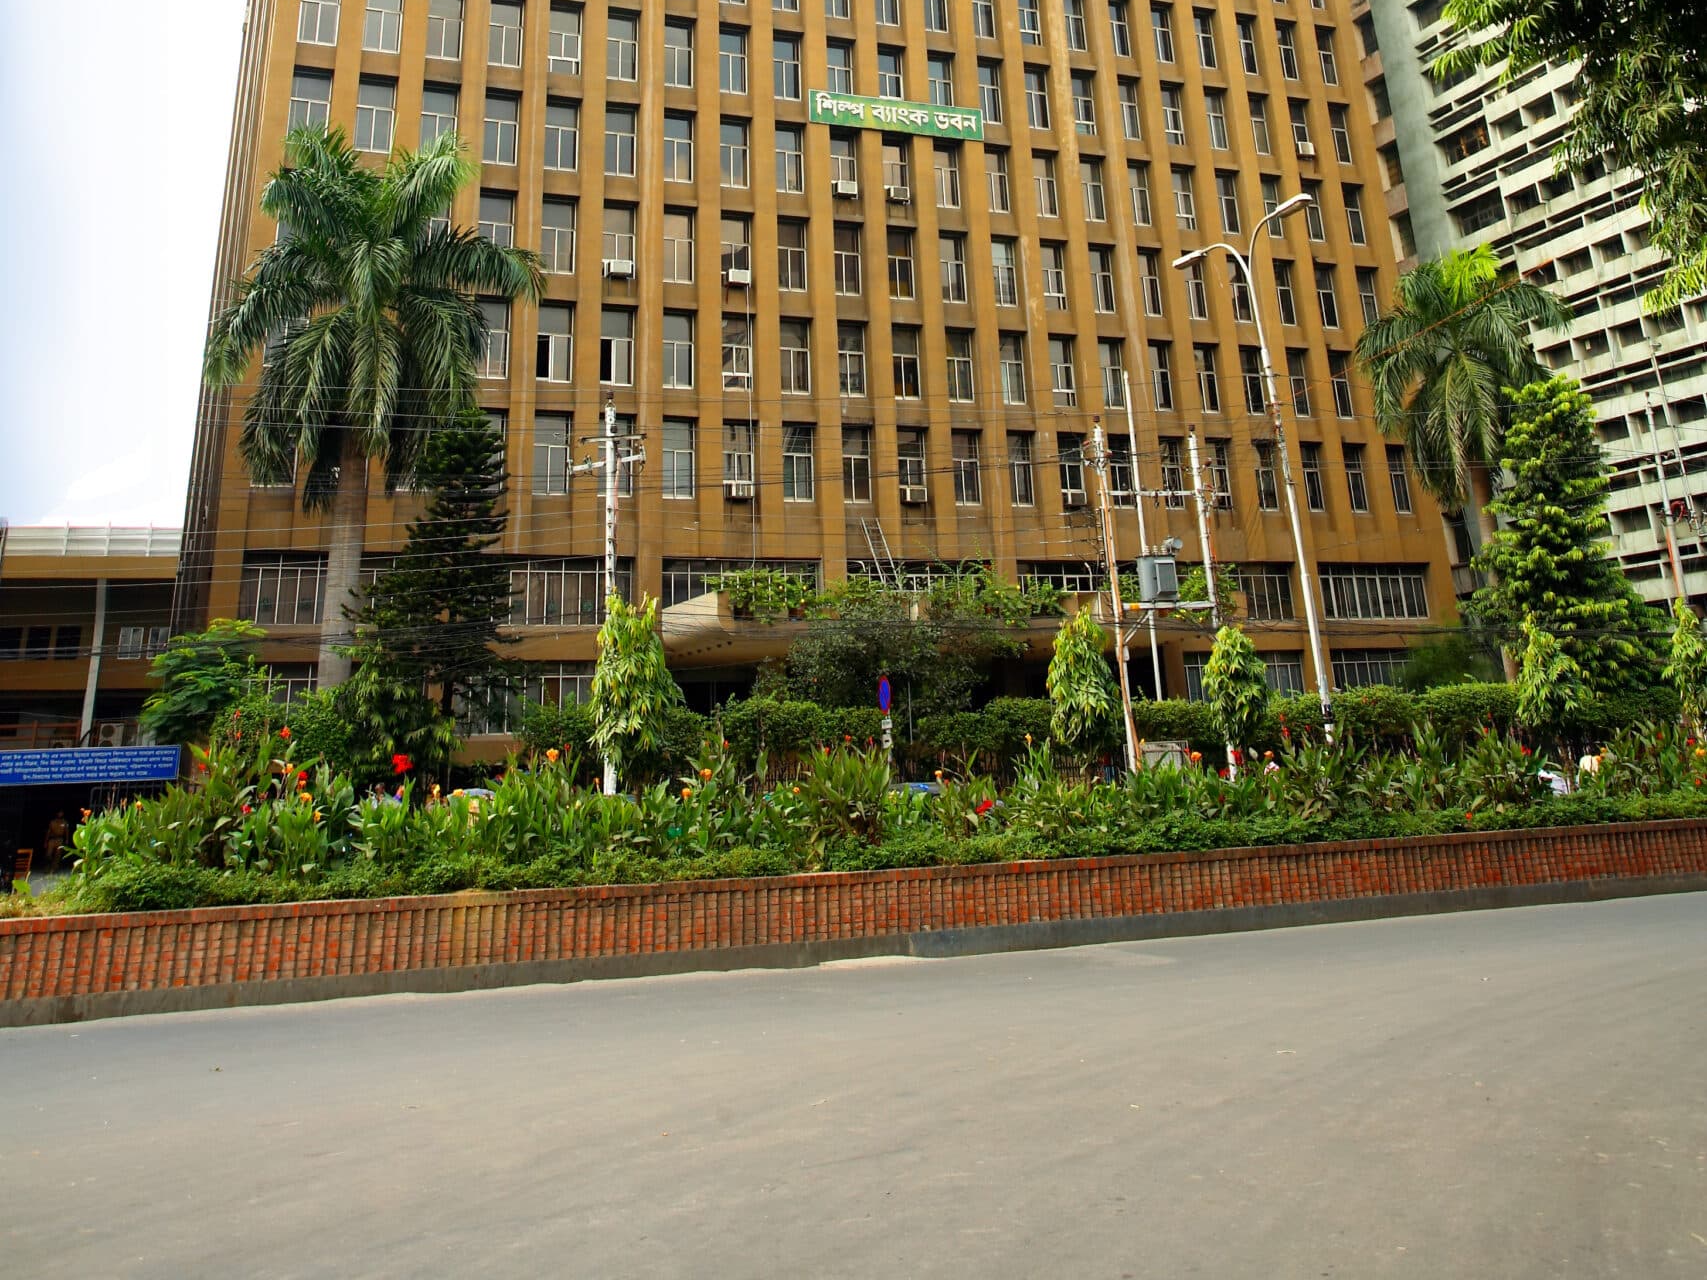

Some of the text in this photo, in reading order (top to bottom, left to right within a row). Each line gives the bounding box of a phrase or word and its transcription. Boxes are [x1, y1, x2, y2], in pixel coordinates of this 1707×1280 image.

[816, 92, 977, 132] শিল্প ব্যাংক ভবন
